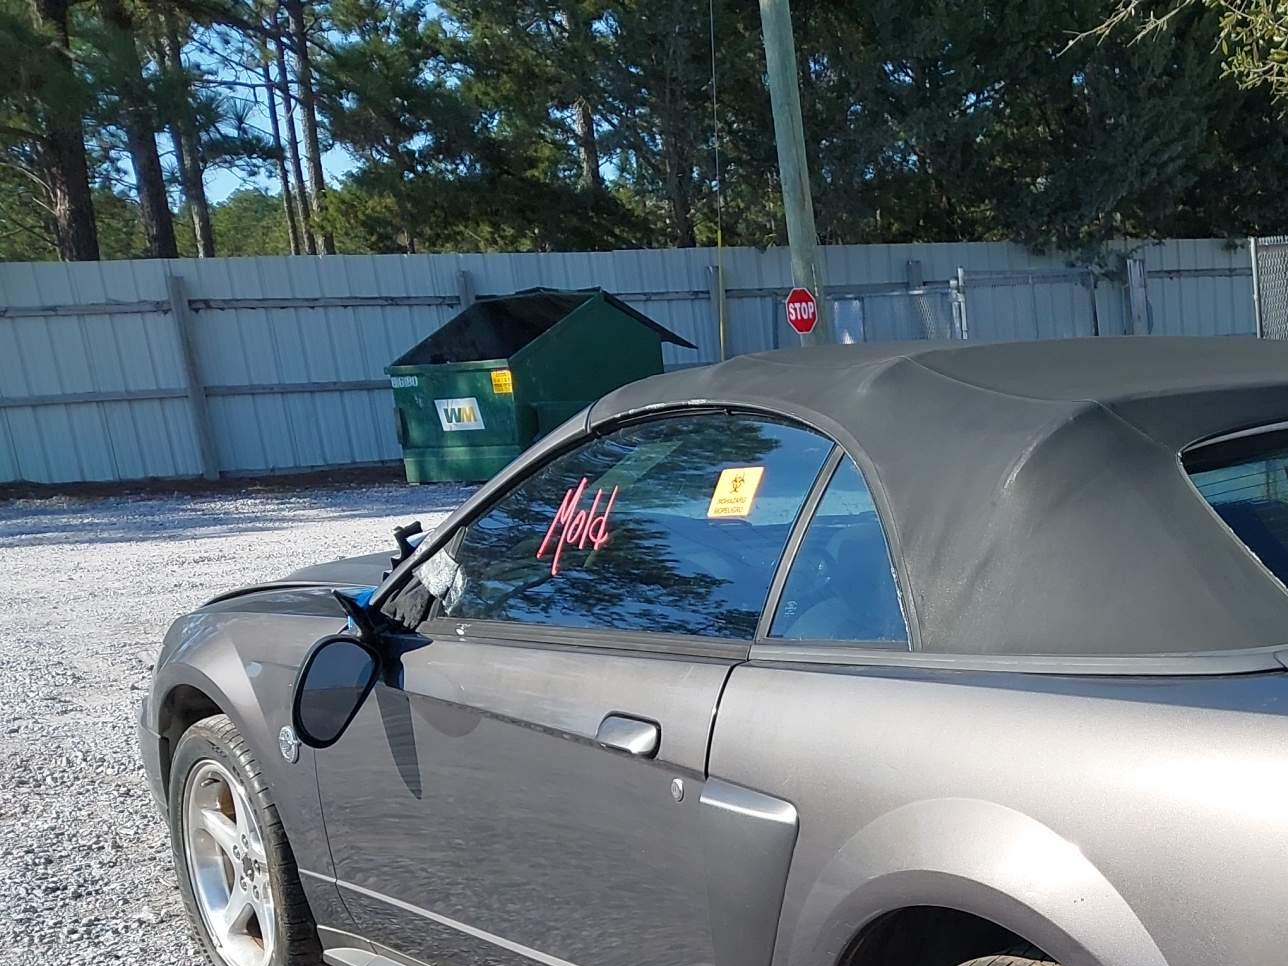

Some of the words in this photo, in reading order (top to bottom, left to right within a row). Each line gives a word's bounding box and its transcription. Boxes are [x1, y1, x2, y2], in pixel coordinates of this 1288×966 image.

[788, 301, 815, 321] STOP
[443, 406, 478, 424] WM
[536, 477, 618, 576] Mold
